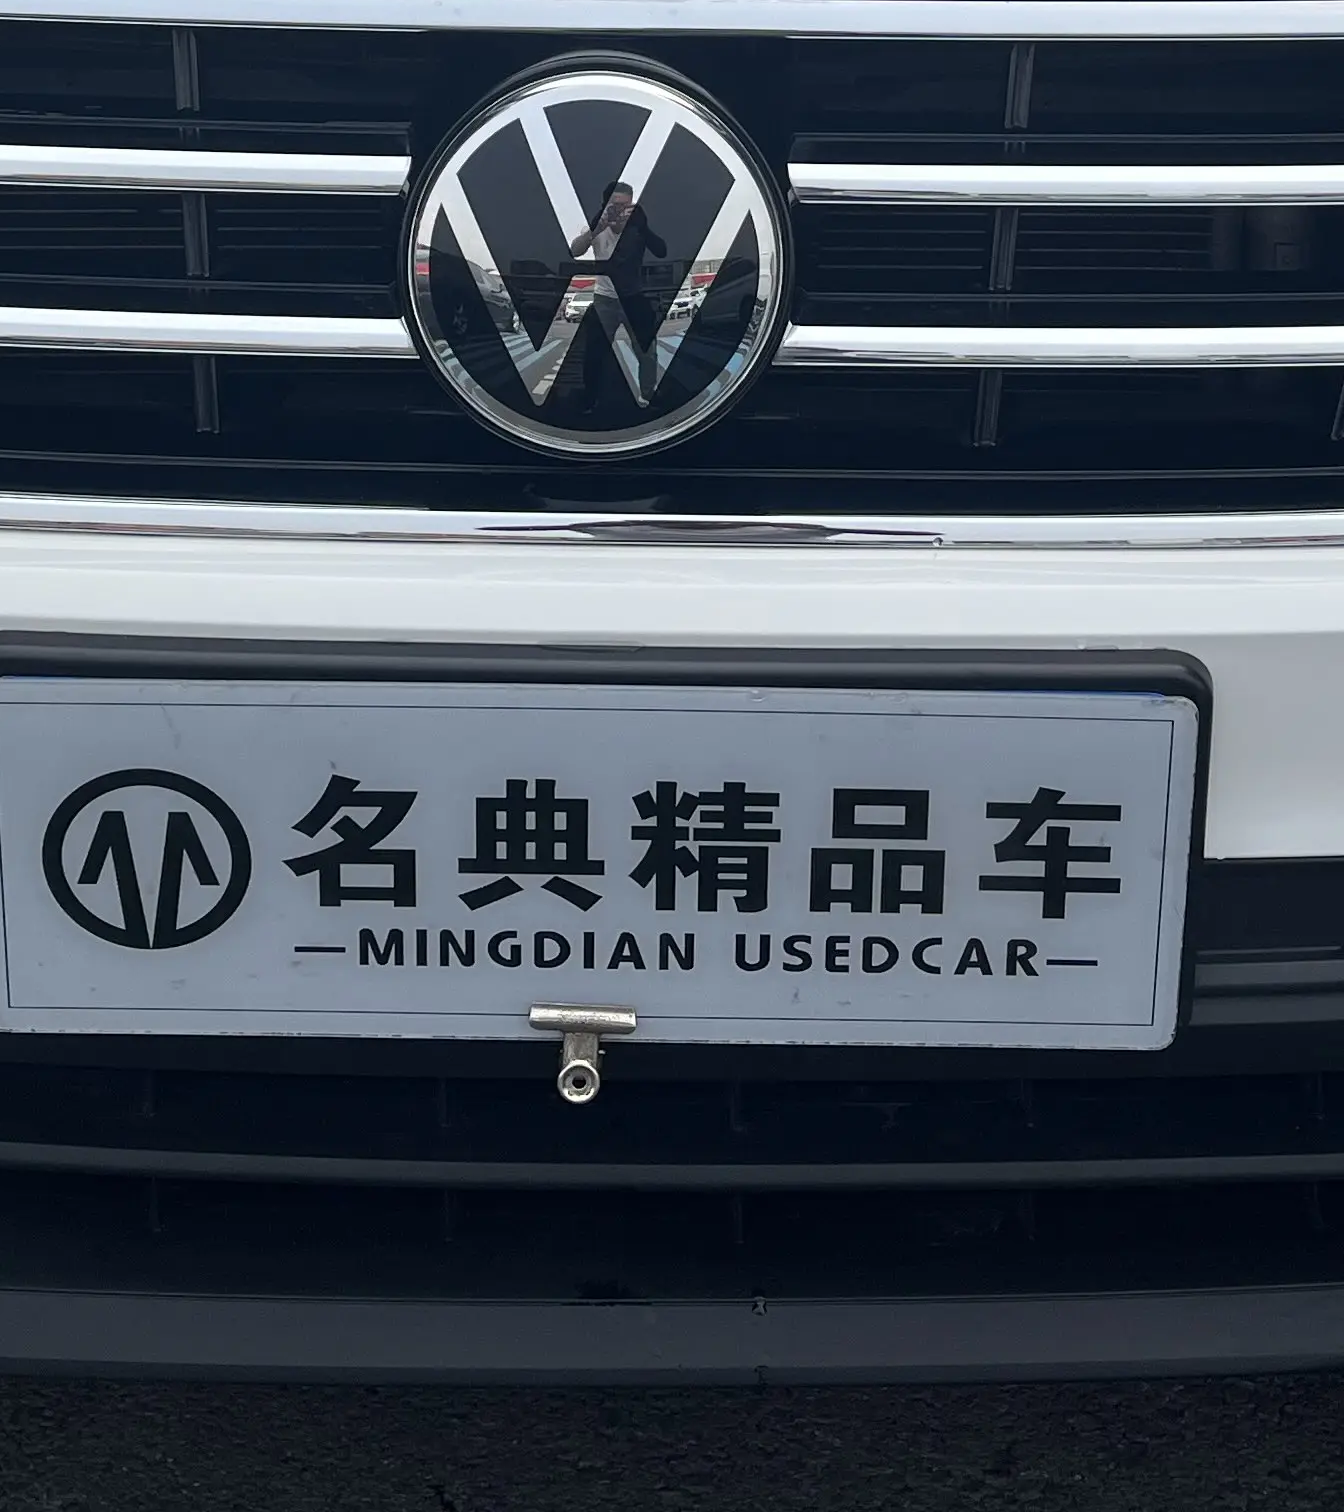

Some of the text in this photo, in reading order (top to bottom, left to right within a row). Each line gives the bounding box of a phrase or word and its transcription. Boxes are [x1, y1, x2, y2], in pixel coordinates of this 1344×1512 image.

[282, 774, 1122, 919] 名典精品车
[359, 928, 1039, 976] MINGDIAN USEDCAR
